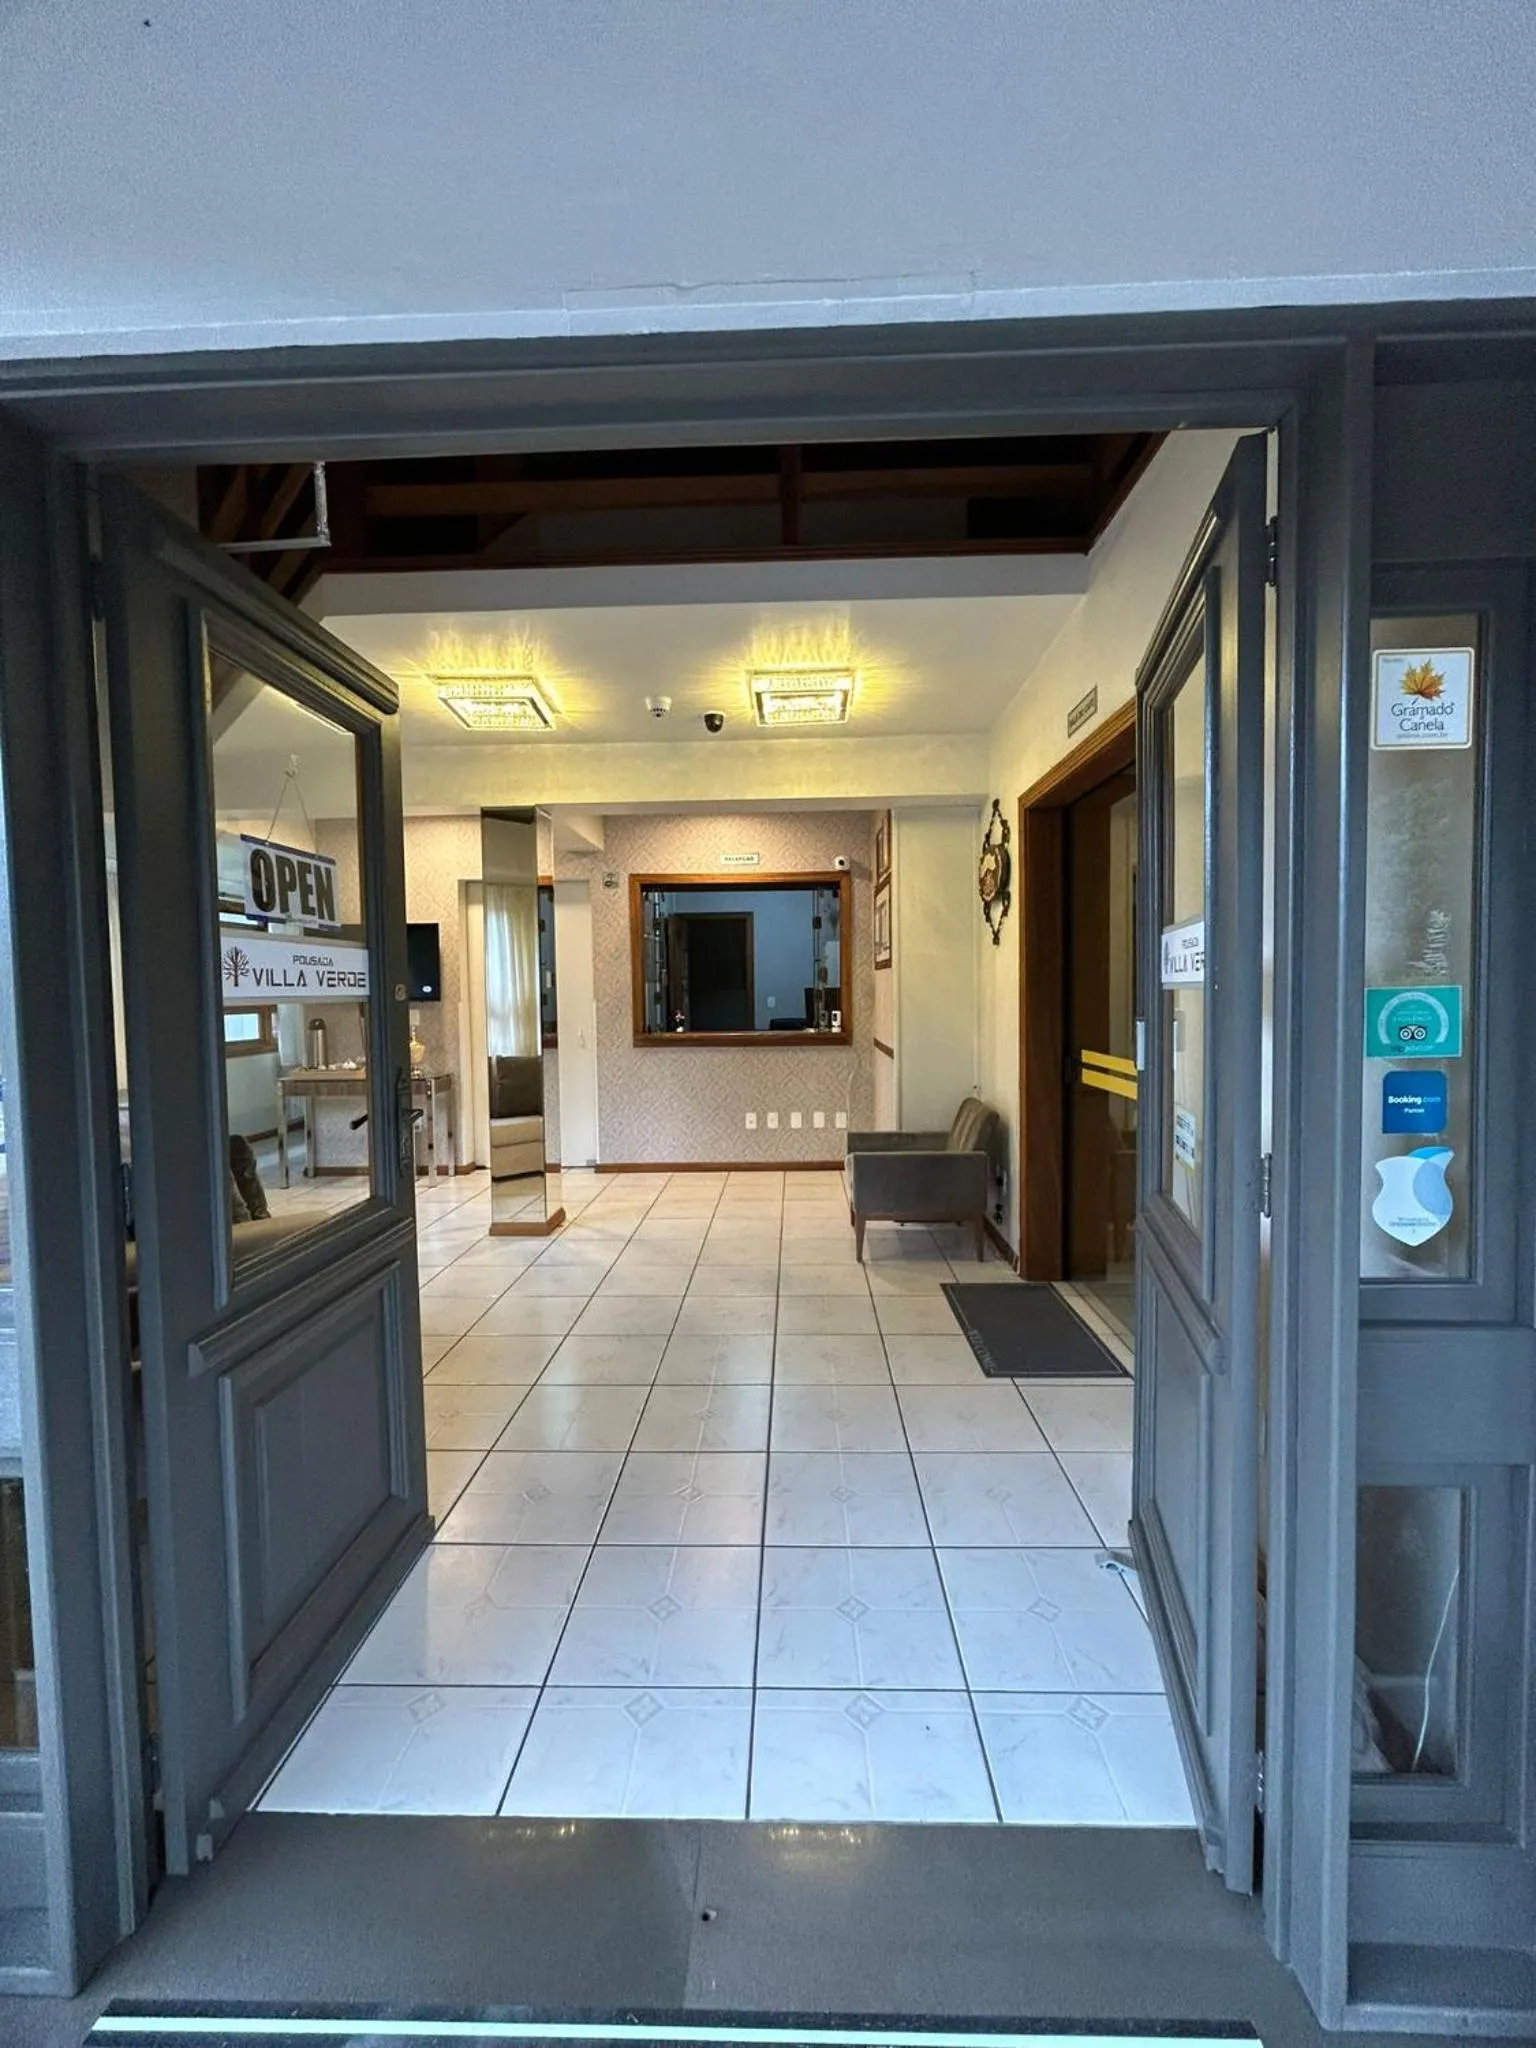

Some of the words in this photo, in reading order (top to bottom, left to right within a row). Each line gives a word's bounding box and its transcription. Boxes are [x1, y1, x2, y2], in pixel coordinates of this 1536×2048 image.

[1399, 718, 1444, 732] Canela
[250, 848, 336, 921] OPEN
[292, 954, 334, 967] POUSADA
[252, 967, 308, 987] VILLA
[316, 970, 367, 988] VERDE
